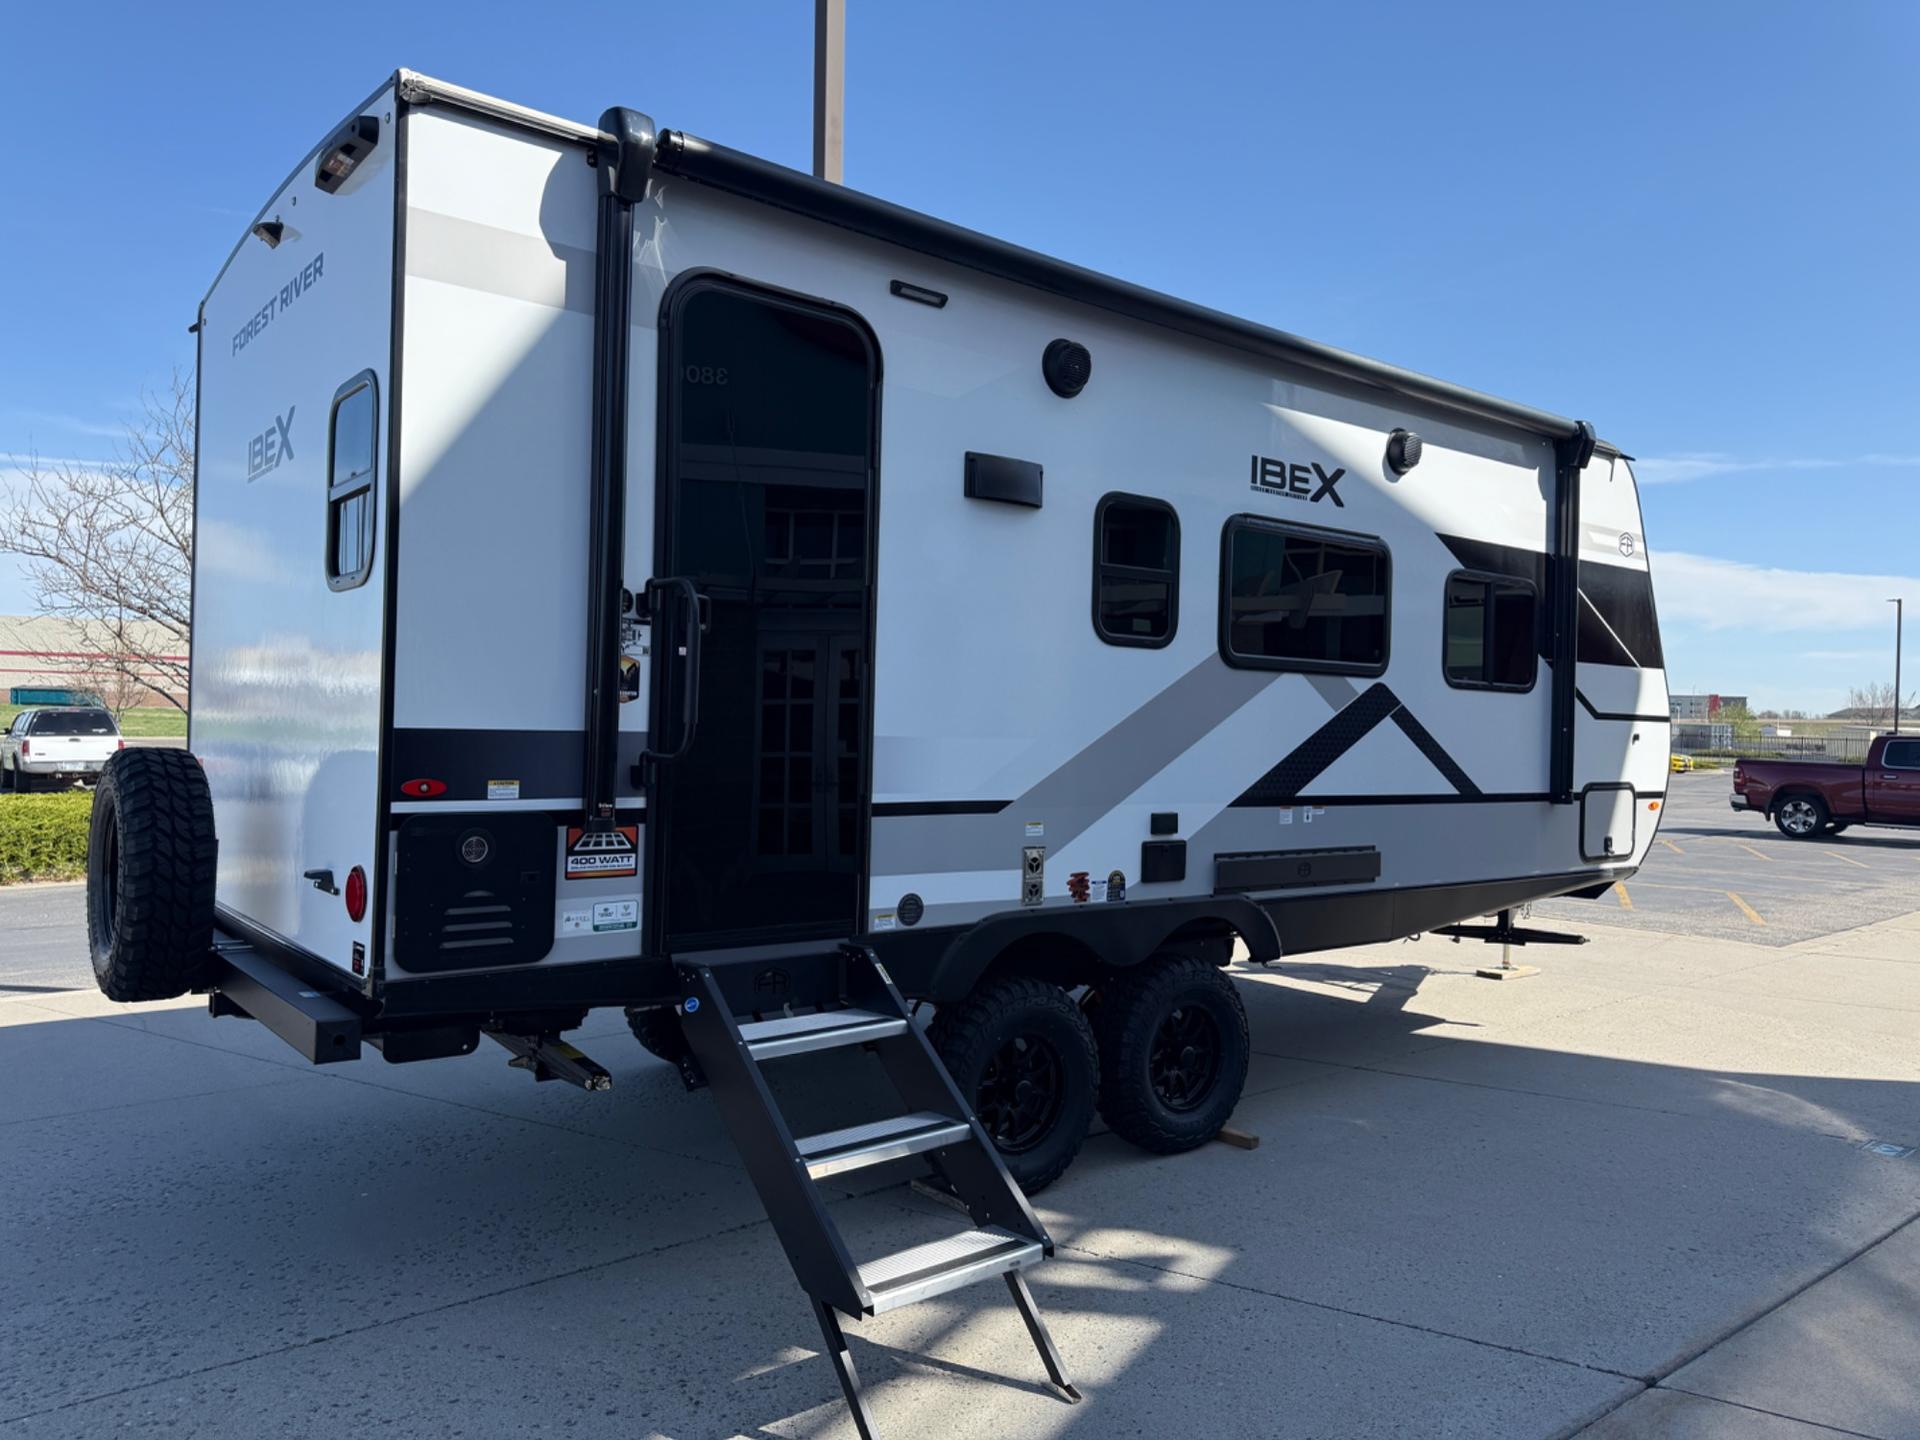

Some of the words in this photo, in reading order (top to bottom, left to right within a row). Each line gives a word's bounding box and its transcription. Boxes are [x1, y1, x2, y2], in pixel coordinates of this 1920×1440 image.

[232, 295, 278, 358] FOREST
[280, 252, 324, 313] RIVER
[1250, 454, 1346, 508] IBEX
[571, 857, 597, 865] 400
[599, 855, 633, 864] WATT
